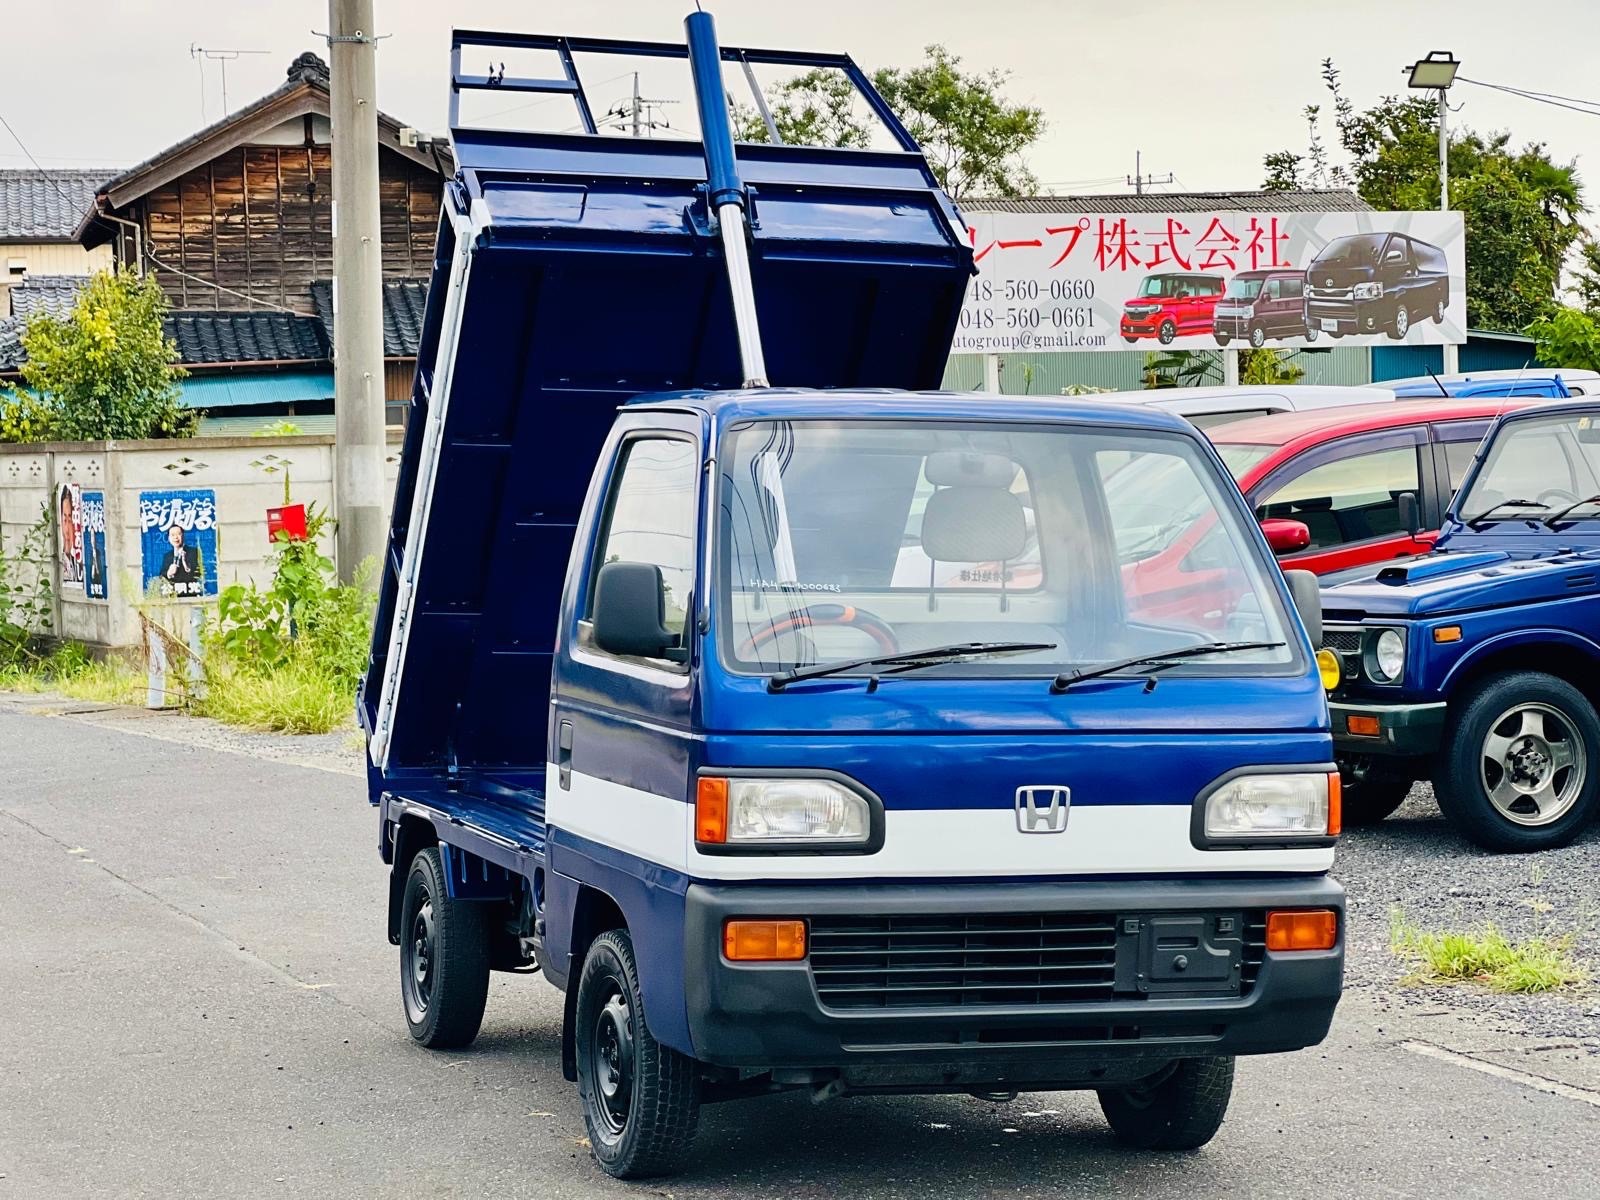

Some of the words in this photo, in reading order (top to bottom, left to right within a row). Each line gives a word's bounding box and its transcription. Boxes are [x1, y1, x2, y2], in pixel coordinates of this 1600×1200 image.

[970, 279, 1095, 301] 48-560-0660
[960, 307, 1096, 329] 048-560-0661
[952, 331, 1106, 350] utogroup@gmail.com
